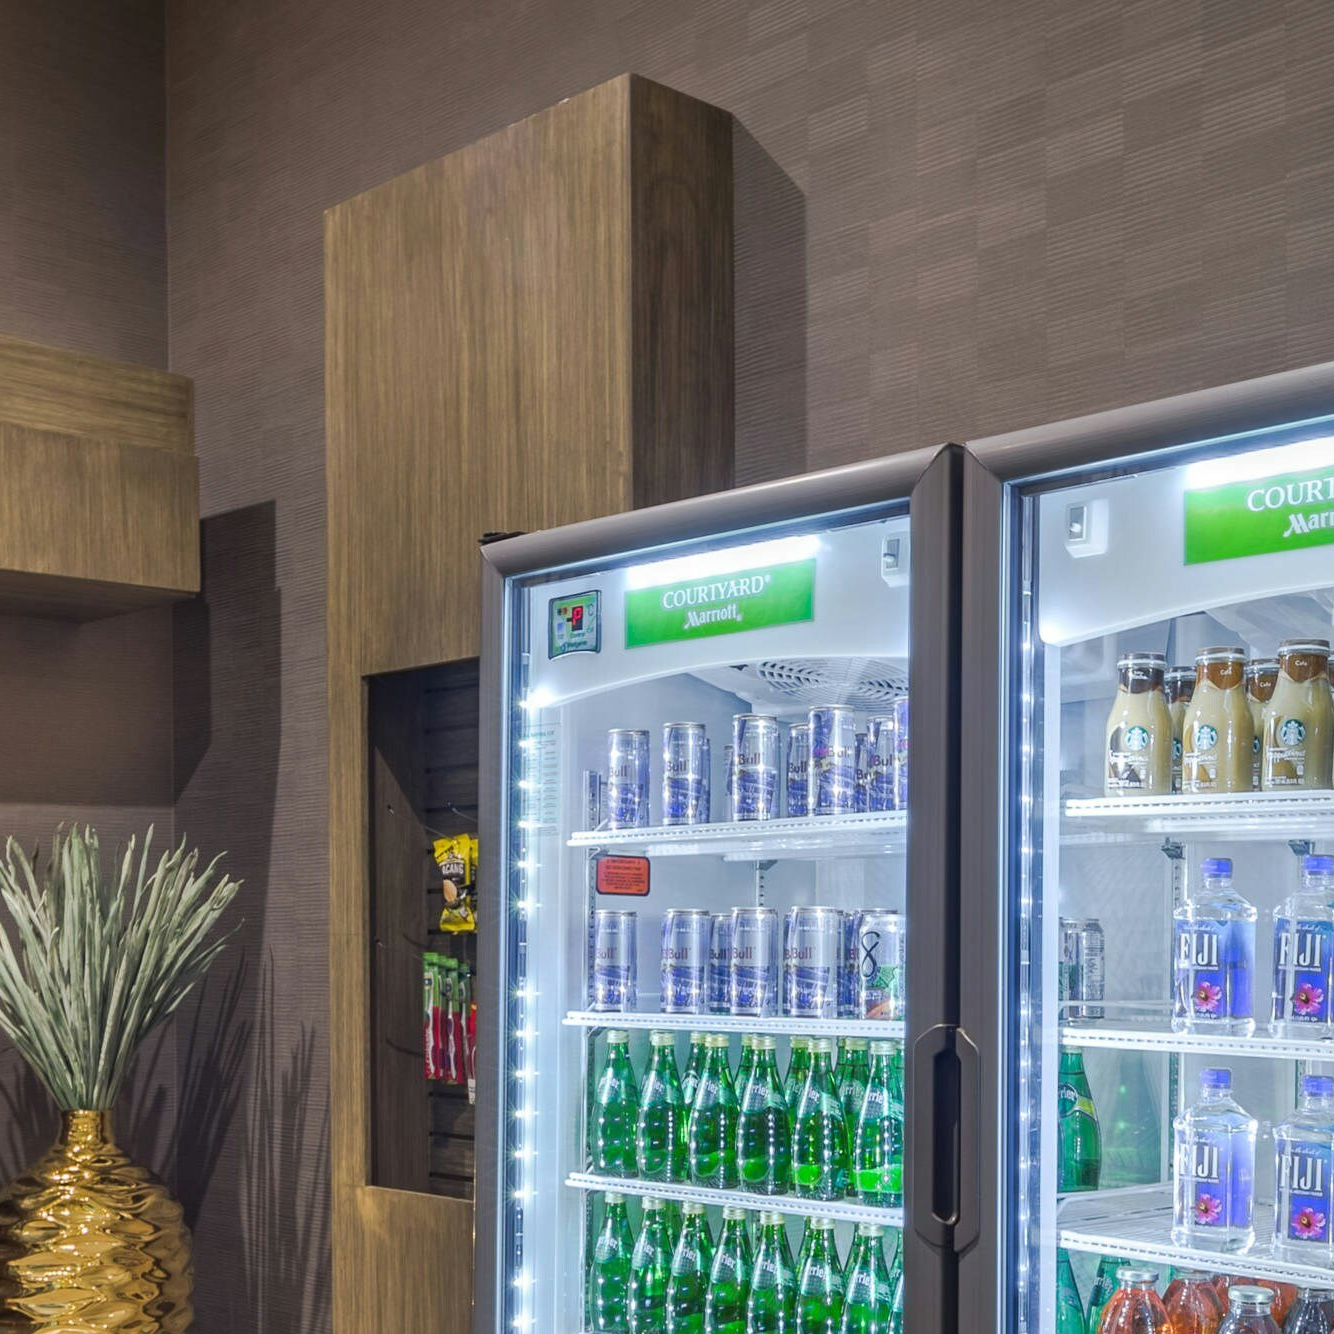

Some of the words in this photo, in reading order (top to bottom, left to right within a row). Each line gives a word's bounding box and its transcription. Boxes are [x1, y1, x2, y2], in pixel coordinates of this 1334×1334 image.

[662, 575, 764, 609] COURTYARD
[684, 603, 737, 629] Marriott
[1279, 932, 1321, 968] FIJI
